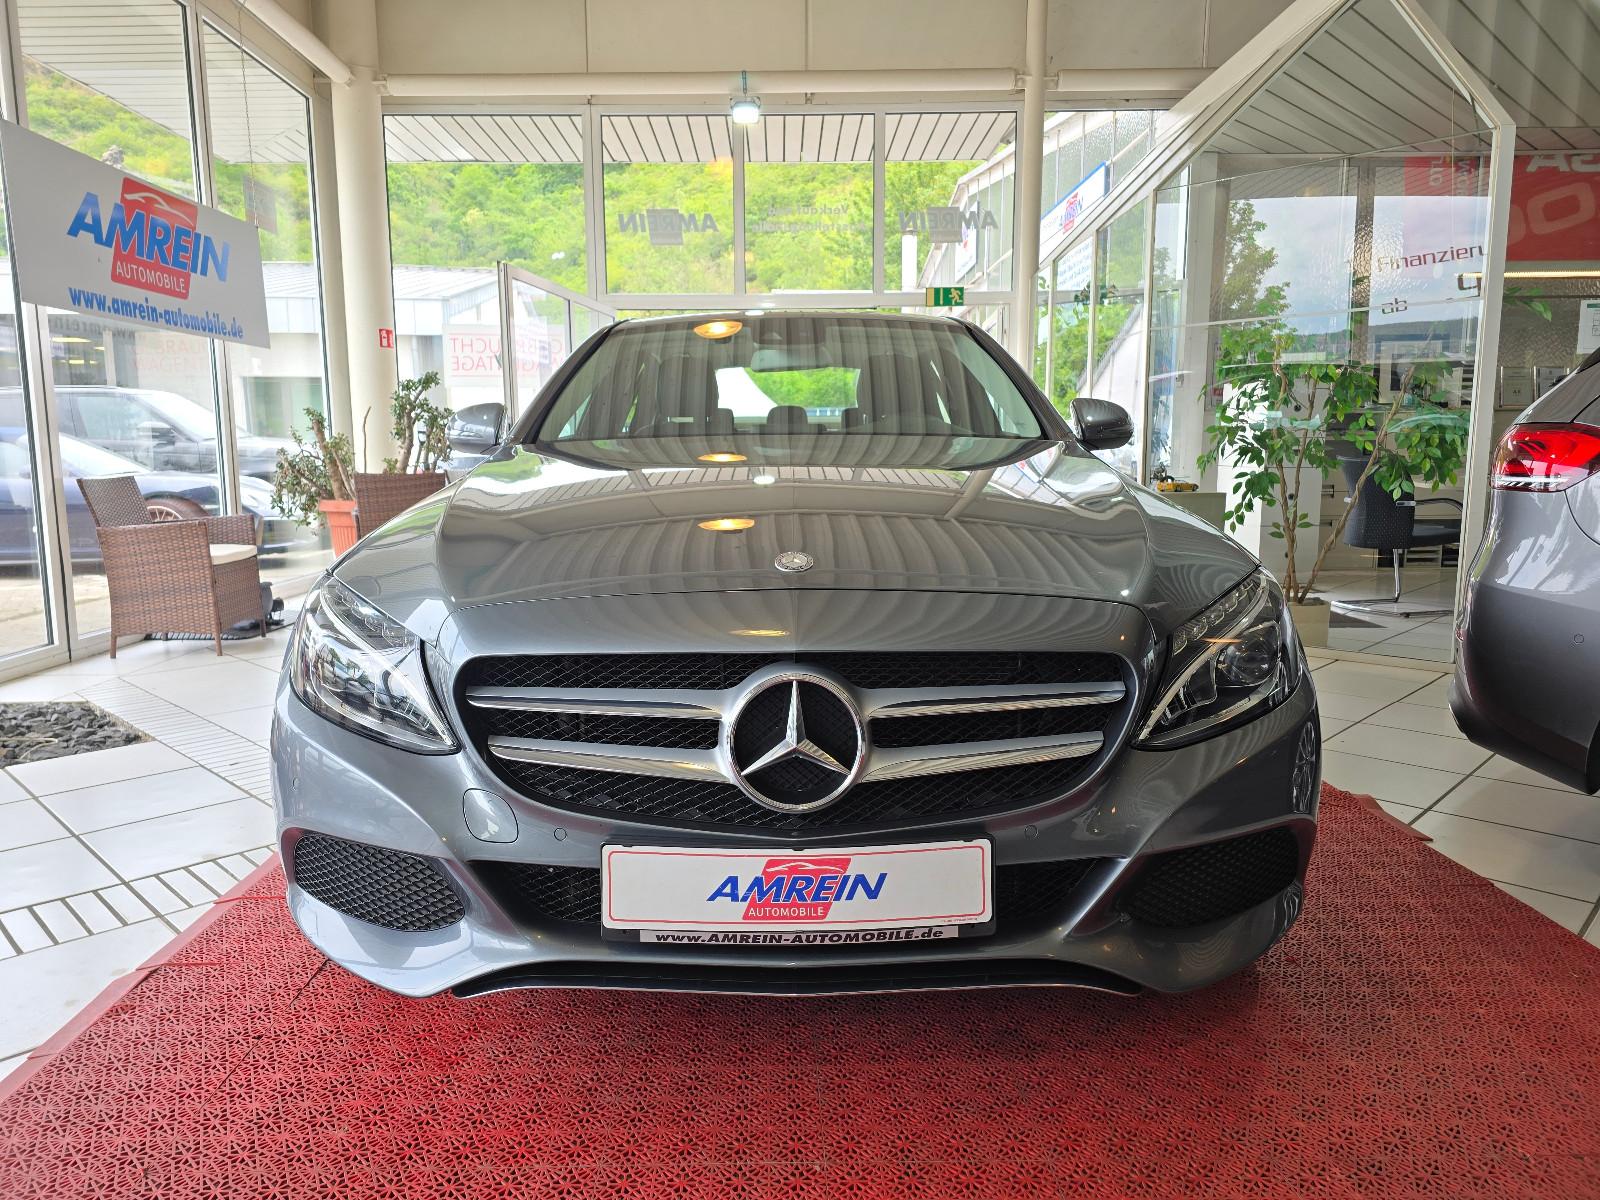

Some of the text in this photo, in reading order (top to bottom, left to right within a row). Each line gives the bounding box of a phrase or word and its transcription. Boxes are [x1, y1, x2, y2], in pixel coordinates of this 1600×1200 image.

[67, 191, 230, 283] AMREIN
[115, 260, 187, 293] AUTOMOBILE
[68, 286, 244, 339] www.amrein-automobile.de
[706, 872, 888, 902] AMREIN
[748, 906, 824, 918] AUTOMOBILE
[655, 928, 944, 945] www.AMREIN-AUTOMOBILE.de
